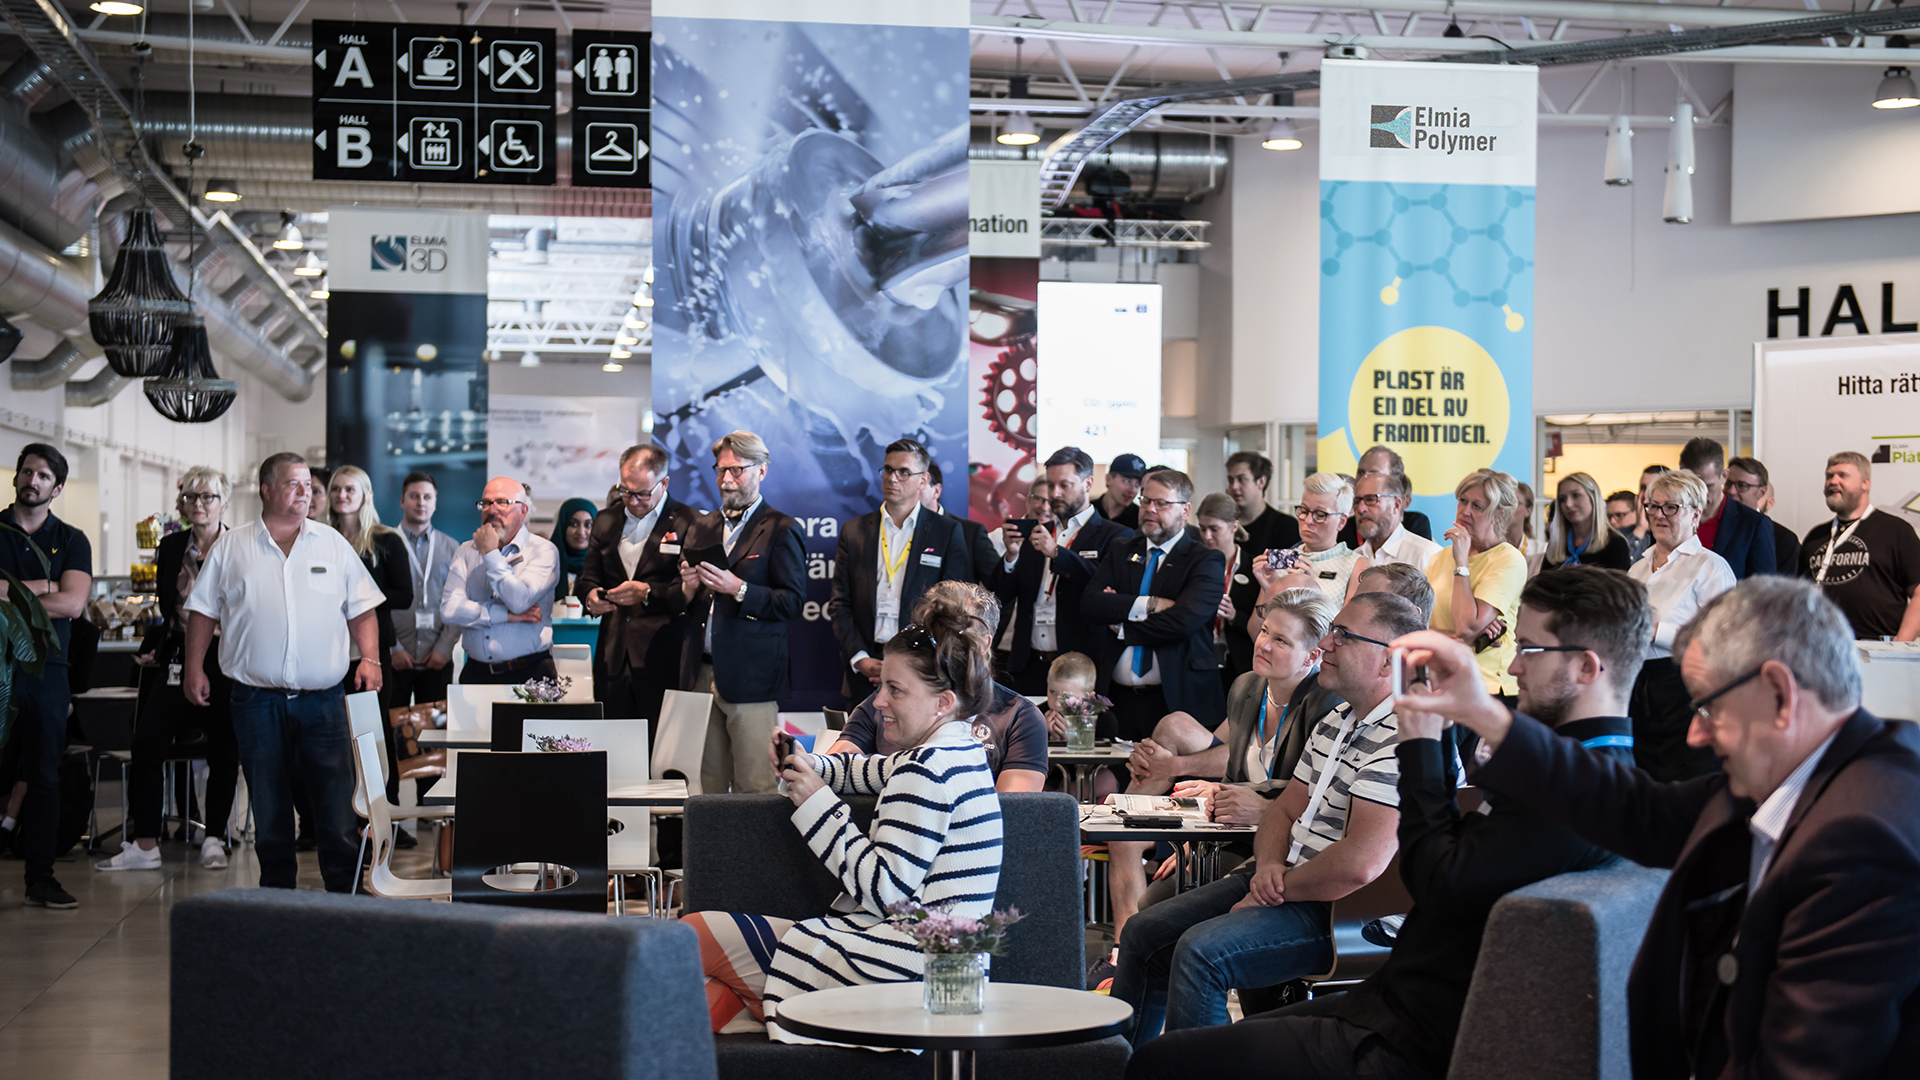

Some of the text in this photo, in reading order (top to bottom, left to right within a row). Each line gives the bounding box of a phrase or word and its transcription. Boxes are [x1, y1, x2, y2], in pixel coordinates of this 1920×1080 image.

[339, 34, 369, 45] HALL
[333, 46, 375, 88] A
[339, 115, 369, 126] HALL
[1414, 106, 1471, 128] Elmia
[337, 126, 373, 168] B
[1414, 129, 1497, 155] Polymer
[410, 235, 448, 246] ELMIA
[410, 247, 448, 274] 3D
[1373, 366, 1465, 391] PLAST ÄR
[1838, 373, 1920, 395] Hitta rät
[1373, 397, 1468, 417] EN DEL AV
[1373, 423, 1490, 444] FRAMTIDEN.
